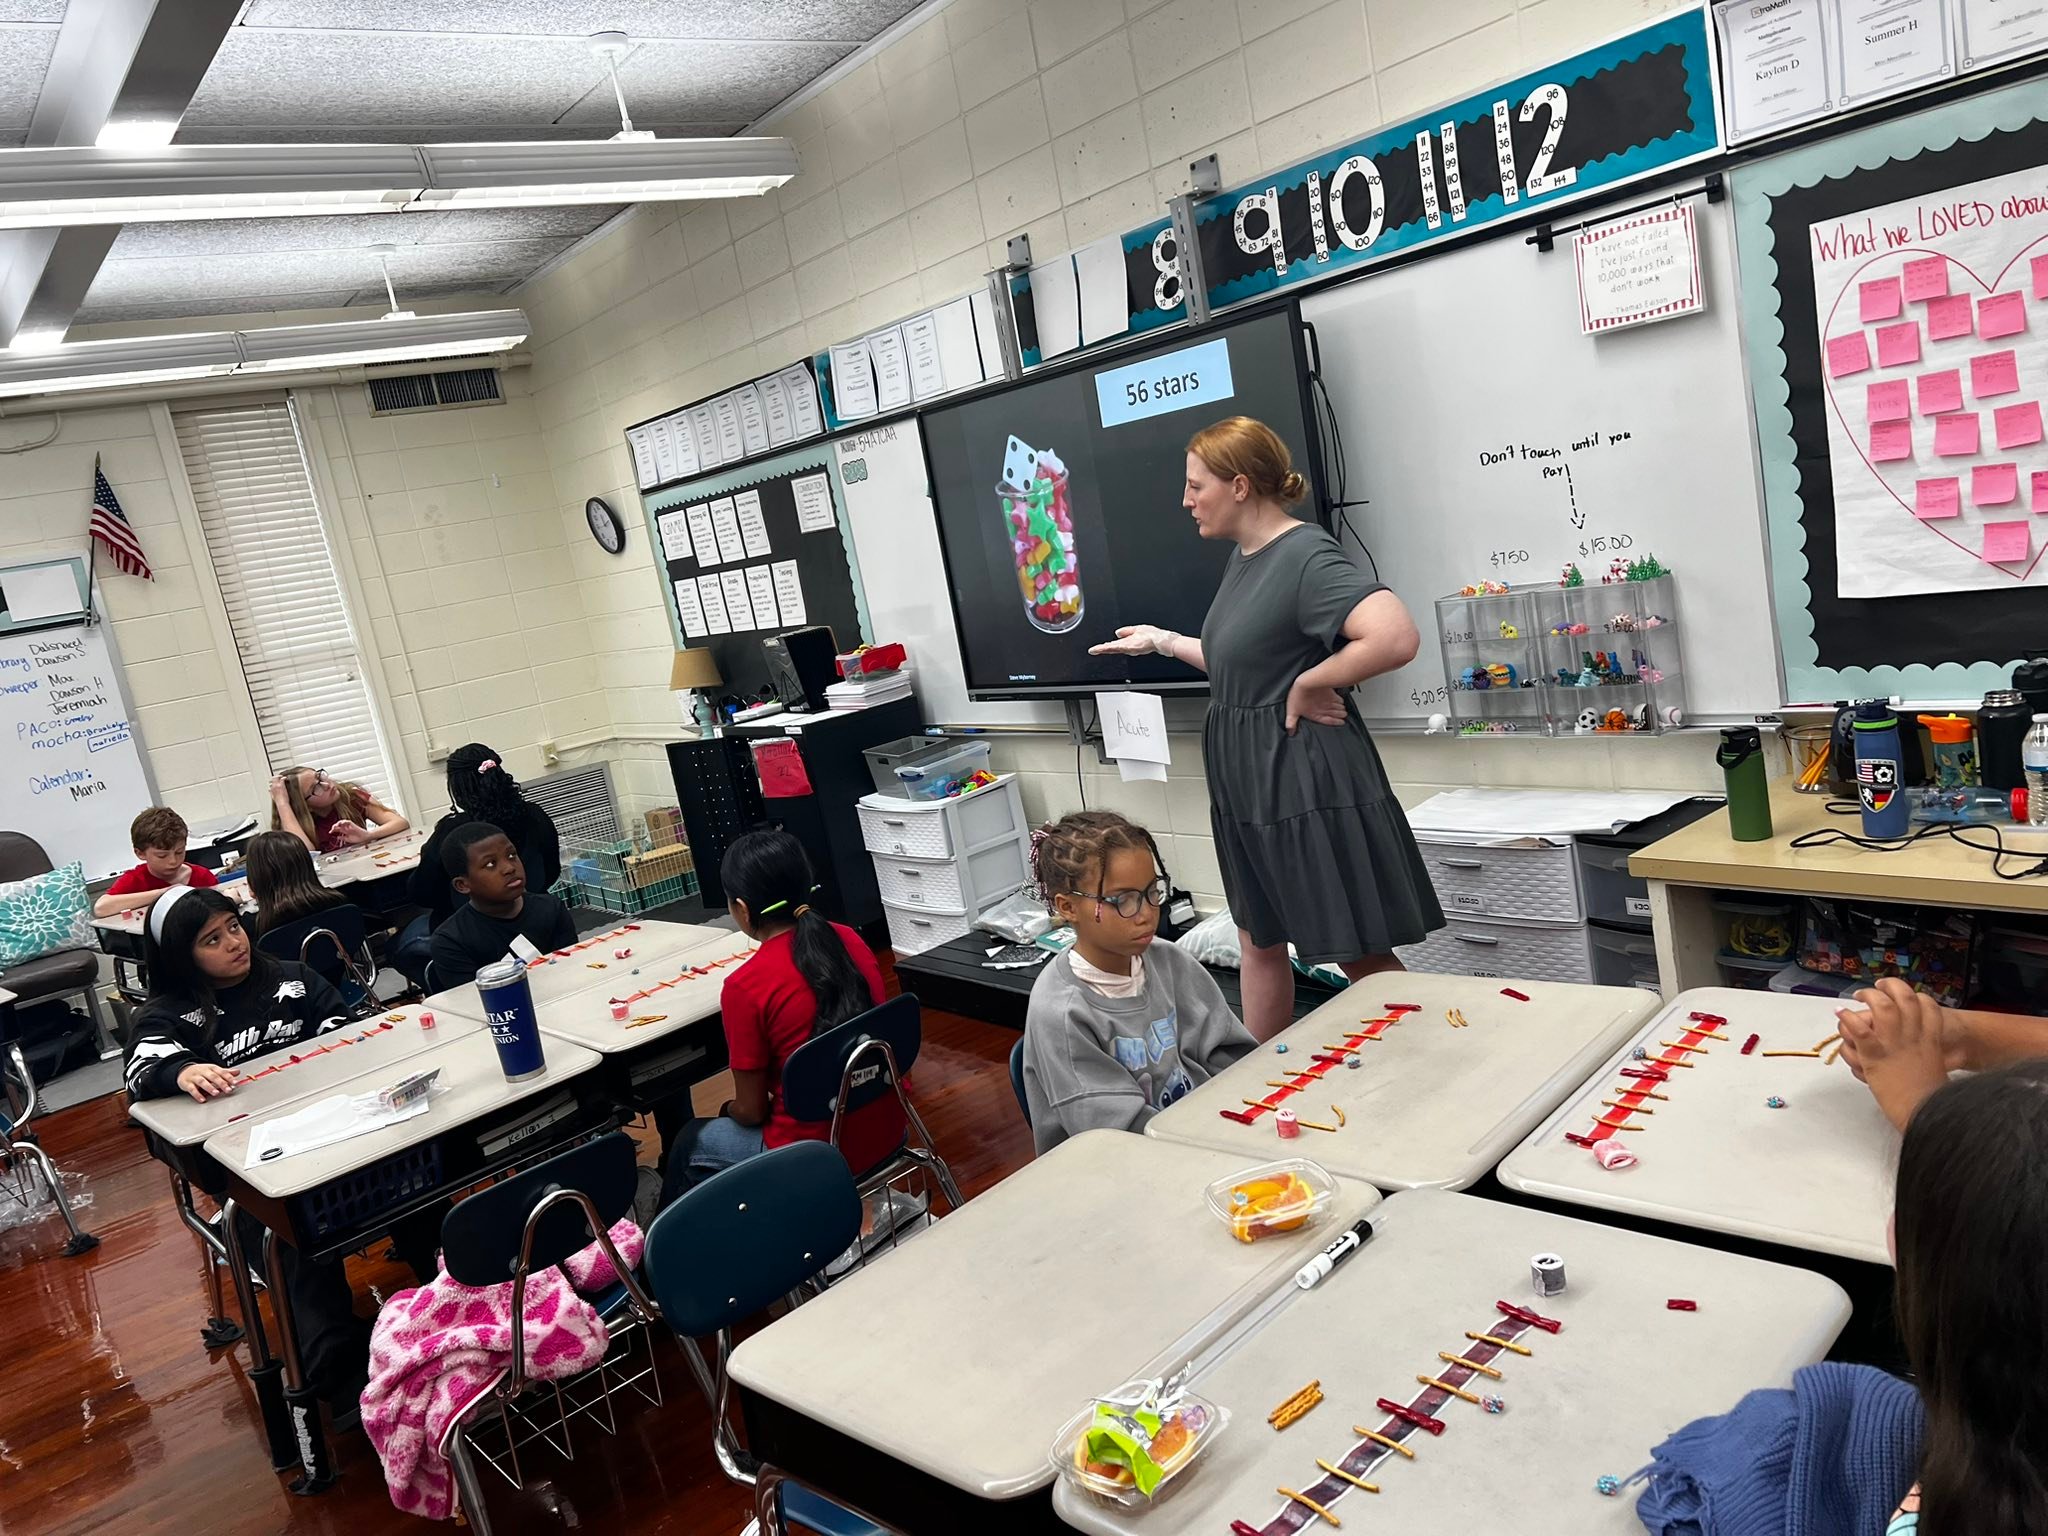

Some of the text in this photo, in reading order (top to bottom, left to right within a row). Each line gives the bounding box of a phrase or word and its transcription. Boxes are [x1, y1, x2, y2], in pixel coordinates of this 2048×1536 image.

[1864, 19, 1919, 46] Summer H
[1755, 58, 1800, 81] Kaylon D
[1546, 88, 1559, 101] 96
[1496, 106, 1505, 117] 12
[1523, 102, 1535, 115] 84
[1442, 127, 1453, 138] 77
[1496, 121, 1507, 133] 24
[1420, 136, 1426, 147] 11
[1493, 83, 1578, 206] 12
[1498, 137, 1510, 149] 36
[1444, 142, 1455, 154] 88
[1541, 143, 1556, 156] 120
[1420, 151, 1430, 162] 22
[1500, 153, 1512, 165] 48
[1346, 159, 1359, 171] 70
[1445, 157, 1457, 169] 99
[1308, 172, 1318, 183] 10
[1415, 120, 1467, 230] 11
[1421, 166, 1431, 177] 33
[1501, 169, 1515, 182] 60
[1446, 173, 1459, 185] 110
[1530, 177, 1543, 189] 132
[1553, 174, 1566, 187] 144
[1310, 187, 1320, 198] 20
[1423, 181, 1434, 193] 44
[1504, 186, 1516, 197] 72
[1268, 189, 1274, 198] 9
[1331, 189, 1342, 202] 80
[1450, 188, 1460, 200] 121
[1246, 198, 1254, 208] 27
[1311, 202, 1322, 214] 30
[1425, 196, 1436, 208] 55
[1236, 209, 1245, 219] 36
[1307, 156, 1385, 264] 10
[1452, 203, 1464, 216] 132
[1427, 211, 1439, 223] 66
[1313, 218, 1324, 230] 40
[1335, 220, 1346, 232] 90
[1234, 186, 1287, 277] 9
[1271, 228, 1279, 239] 81
[1814, 217, 1878, 262] What
[1883, 225, 1912, 249] we
[1918, 200, 1995, 241] LOVED
[1260, 237, 1270, 247] 72
[1272, 239, 1282, 251] 90
[1314, 234, 1326, 246] 50
[1354, 235, 1370, 248] 100
[1601, 242, 1621, 254] have
[1624, 235, 1639, 247] not
[1642, 227, 1669, 244] failed
[1248, 242, 1257, 252] 63
[1274, 251, 1284, 262] 99
[1317, 250, 1329, 261] 60
[1600, 243, 1668, 269] I've just found
[1168, 261, 1176, 270] 48
[1598, 255, 1674, 284] 10,000 ways that
[1610, 274, 1660, 293] don't work
[1171, 295, 1181, 305] 80
[1615, 296, 1668, 314] Thomas Edison
[1125, 368, 1200, 407] 56 stars
[1480, 429, 1631, 467] Don't touch until you
[1579, 534, 1633, 558] $15.00
[0, 657, 31, 672] brary
[34, 652, 78, 668] Dawson
[49, 685, 91, 702] Dawson
[93, 676, 104, 690] H
[47, 695, 108, 715] Jeremiah
[1116, 709, 1151, 738] Acute
[69, 780, 107, 802] Maria
[214, 1025, 261, 1060] Faith
